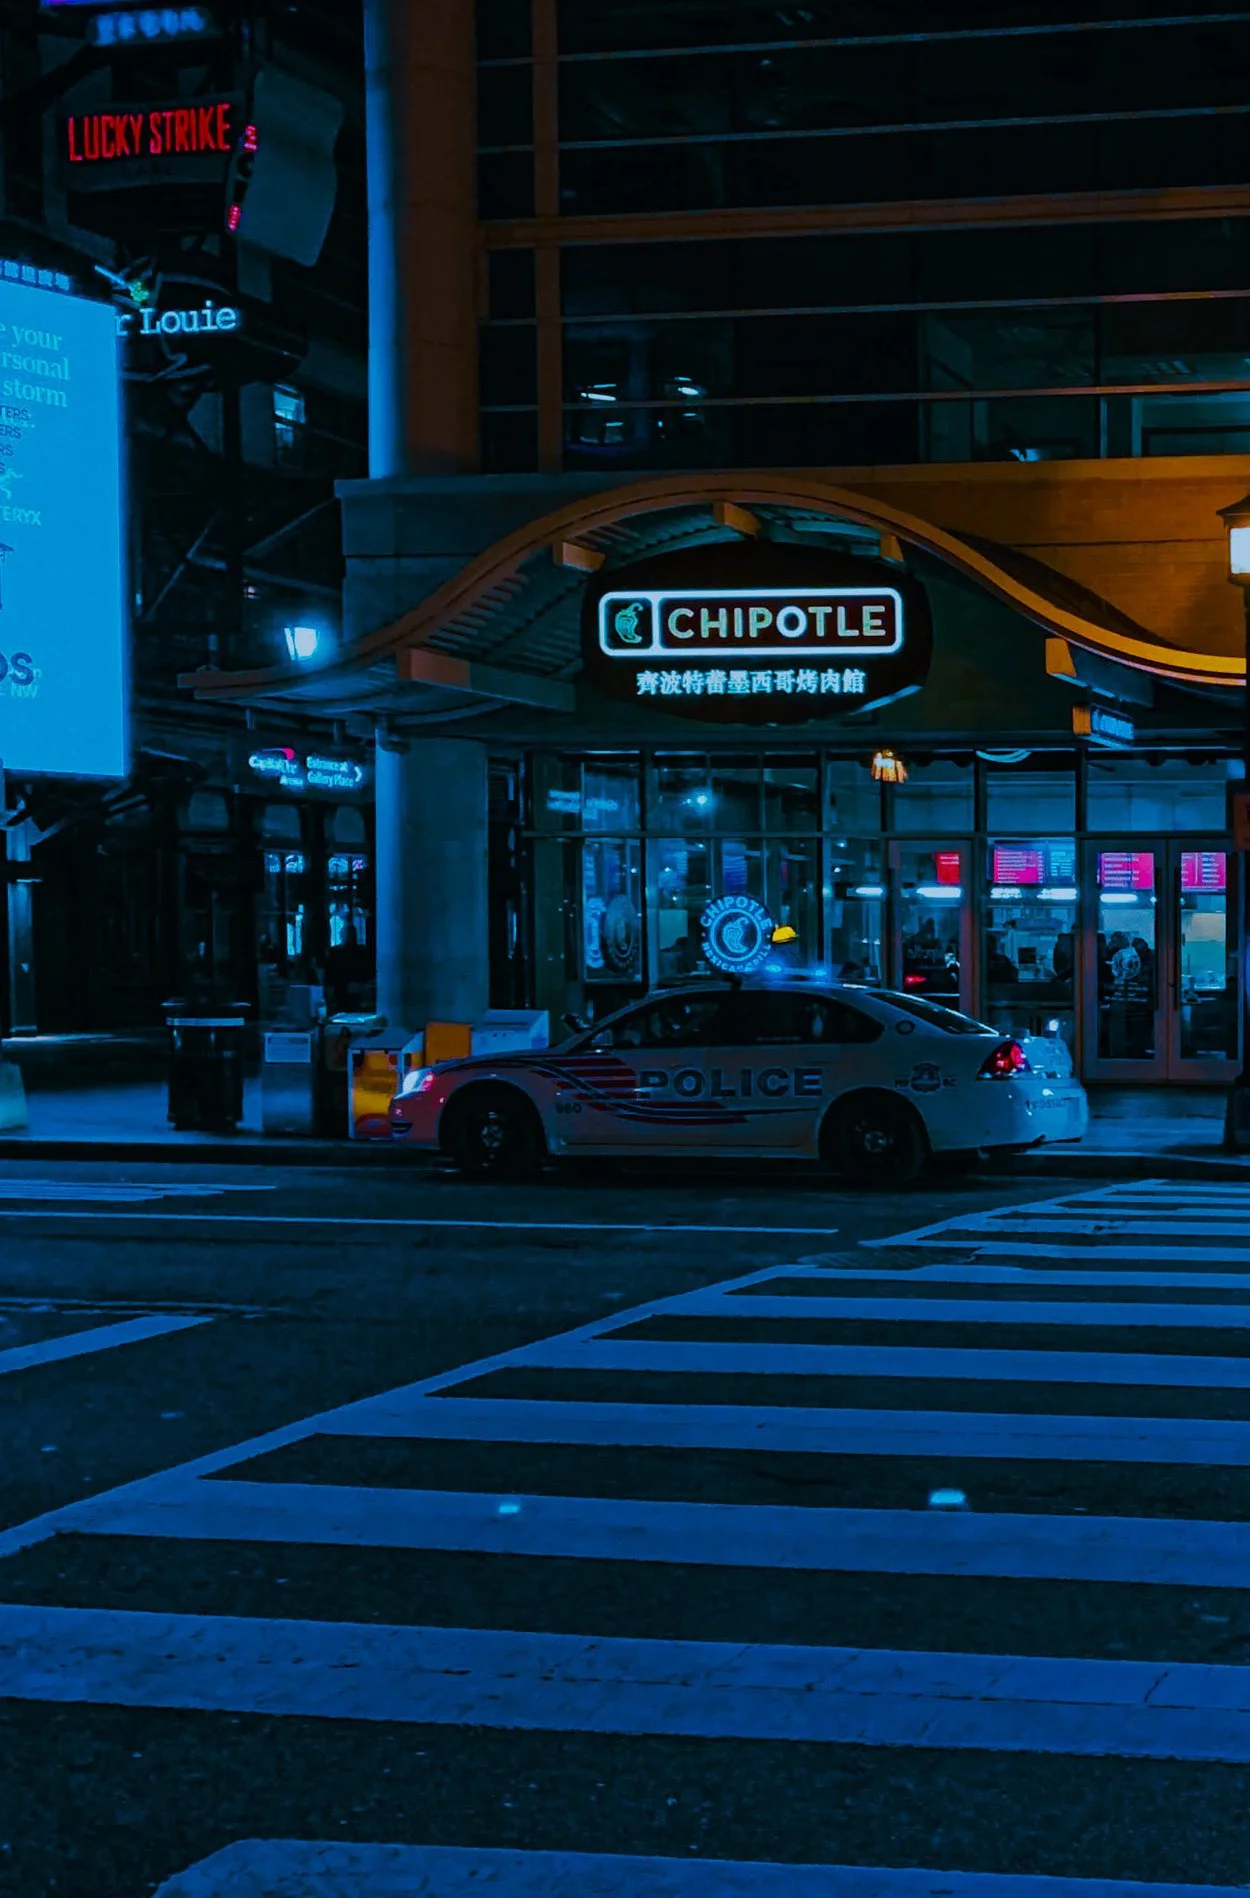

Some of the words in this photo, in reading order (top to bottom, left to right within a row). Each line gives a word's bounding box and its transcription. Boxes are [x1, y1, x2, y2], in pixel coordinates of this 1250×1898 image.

[67, 113, 144, 162] LUCKY
[150, 103, 232, 155] STRIKE
[140, 300, 237, 336] Louie
[11, 325, 63, 351] your
[3, 379, 69, 408] storm
[667, 605, 886, 639] CHIPOTLE
[700, 896, 773, 930] CHIPOTLE
[638, 1067, 824, 1098] POLICE
